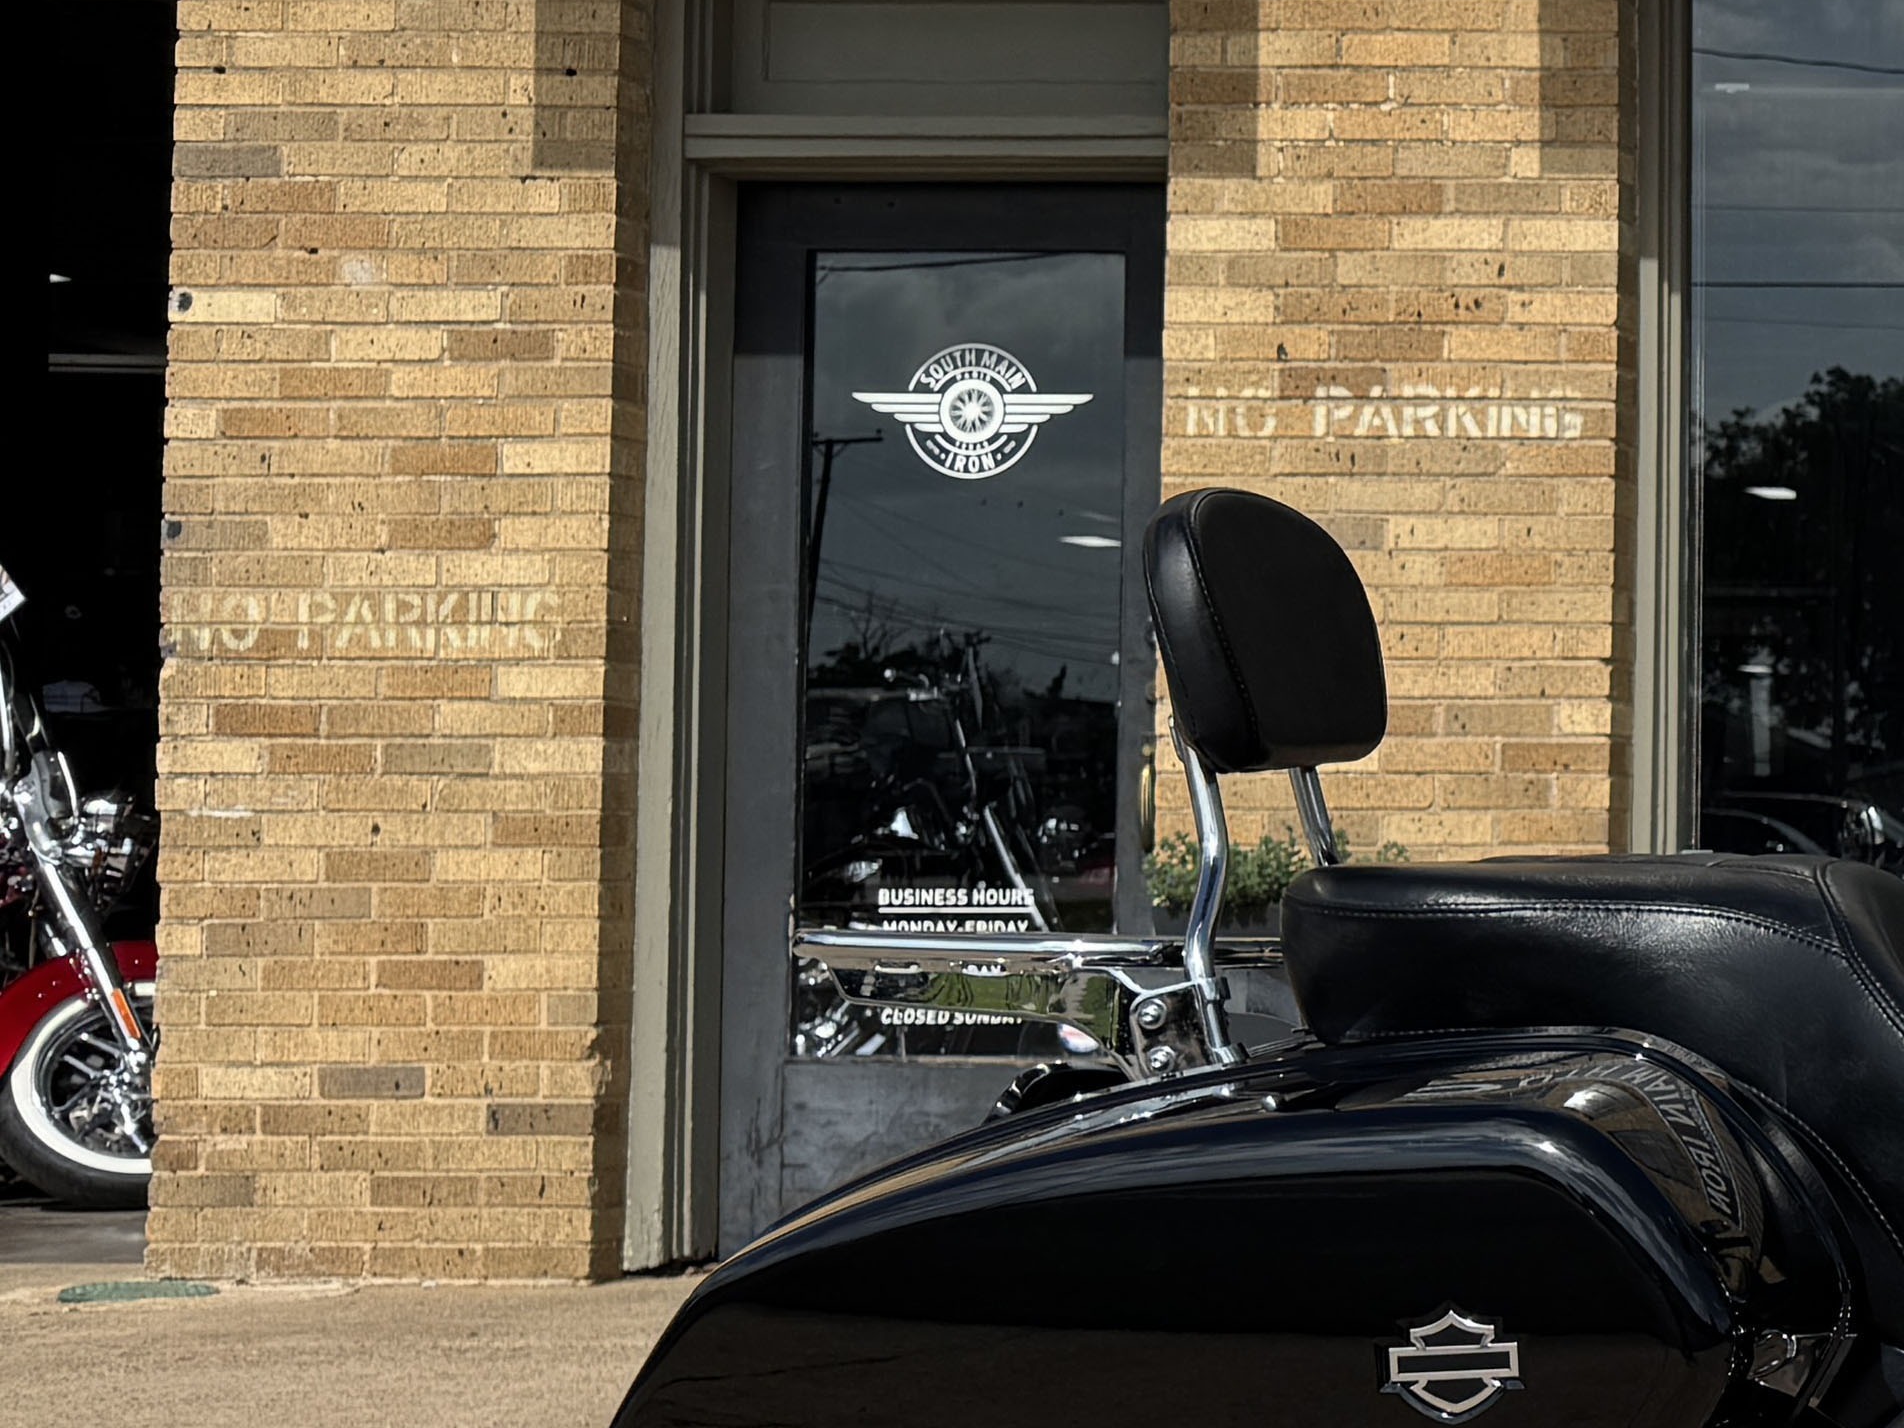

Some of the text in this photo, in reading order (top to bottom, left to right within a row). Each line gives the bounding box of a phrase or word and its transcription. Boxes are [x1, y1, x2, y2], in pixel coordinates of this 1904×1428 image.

[920, 348, 1026, 390] SOUTH MAIN
[945, 452, 996, 473] IRON
[878, 888, 1035, 906] BUSINESS HOURS
